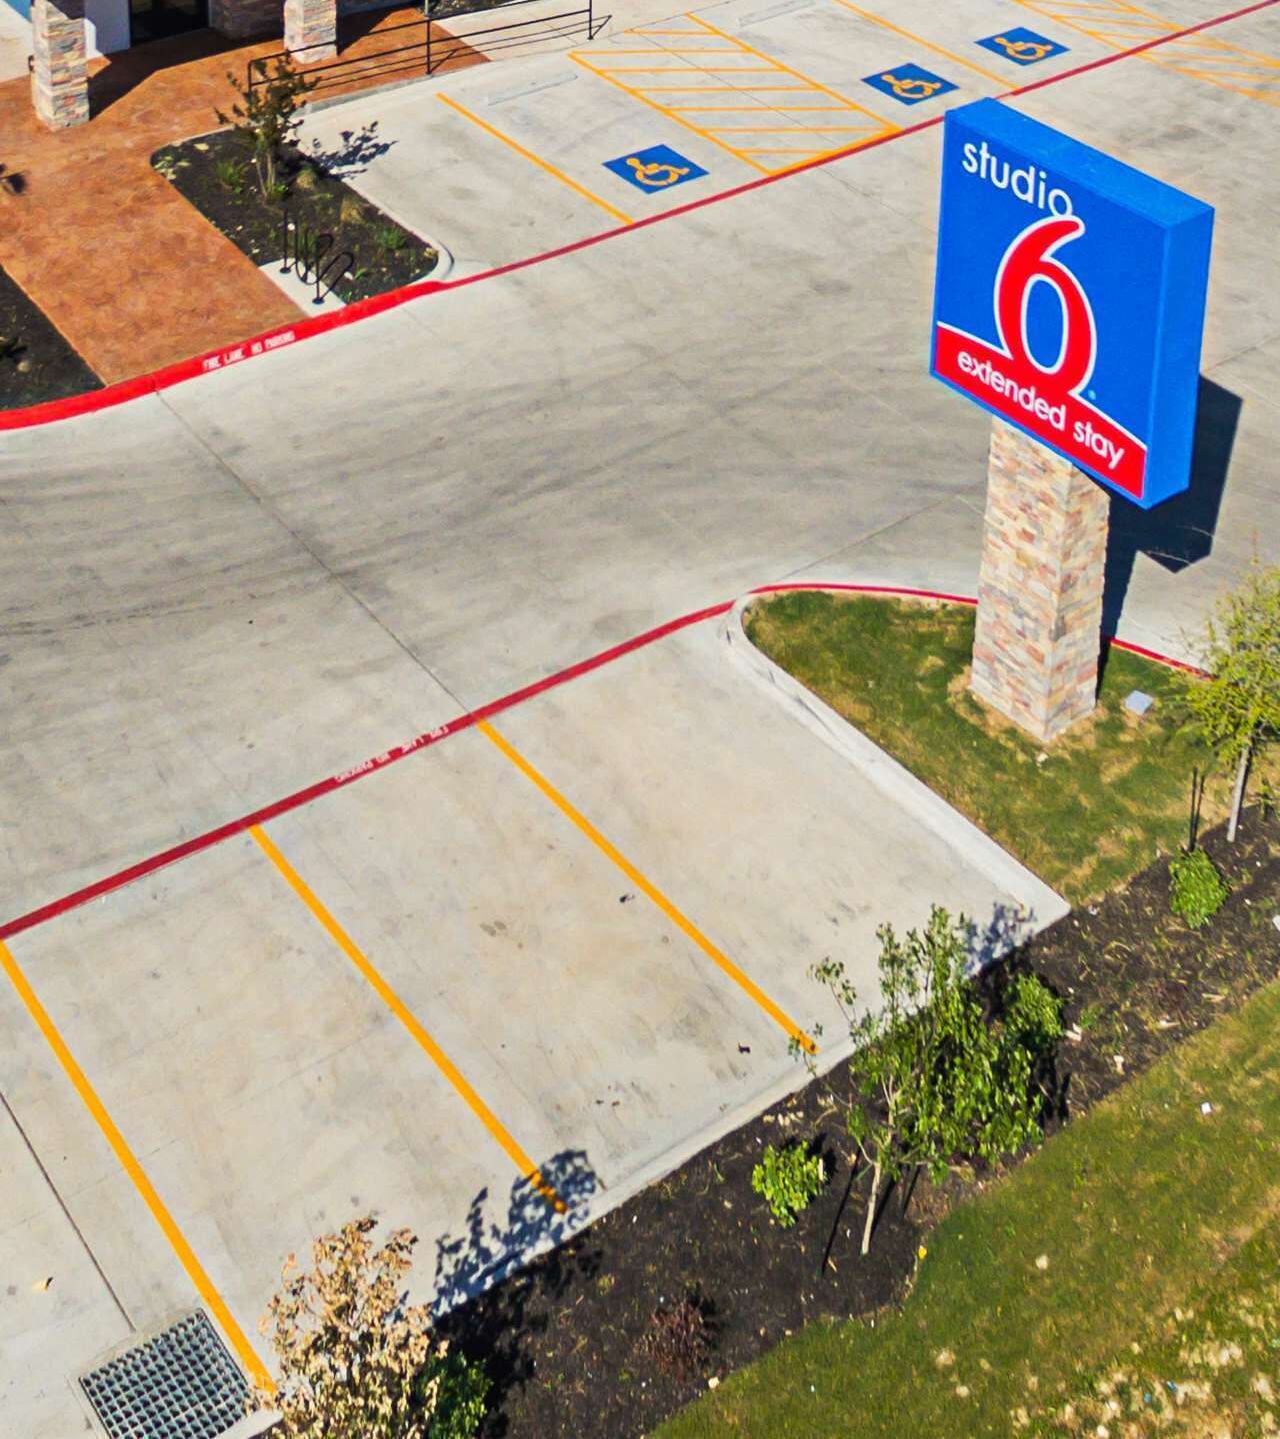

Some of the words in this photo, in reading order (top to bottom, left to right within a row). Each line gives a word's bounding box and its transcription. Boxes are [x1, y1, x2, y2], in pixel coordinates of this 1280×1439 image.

[961, 141, 1073, 217] studio
[993, 214, 1097, 394] 6
[957, 349, 1066, 430] extended
[1073, 418, 1125, 469] stay
